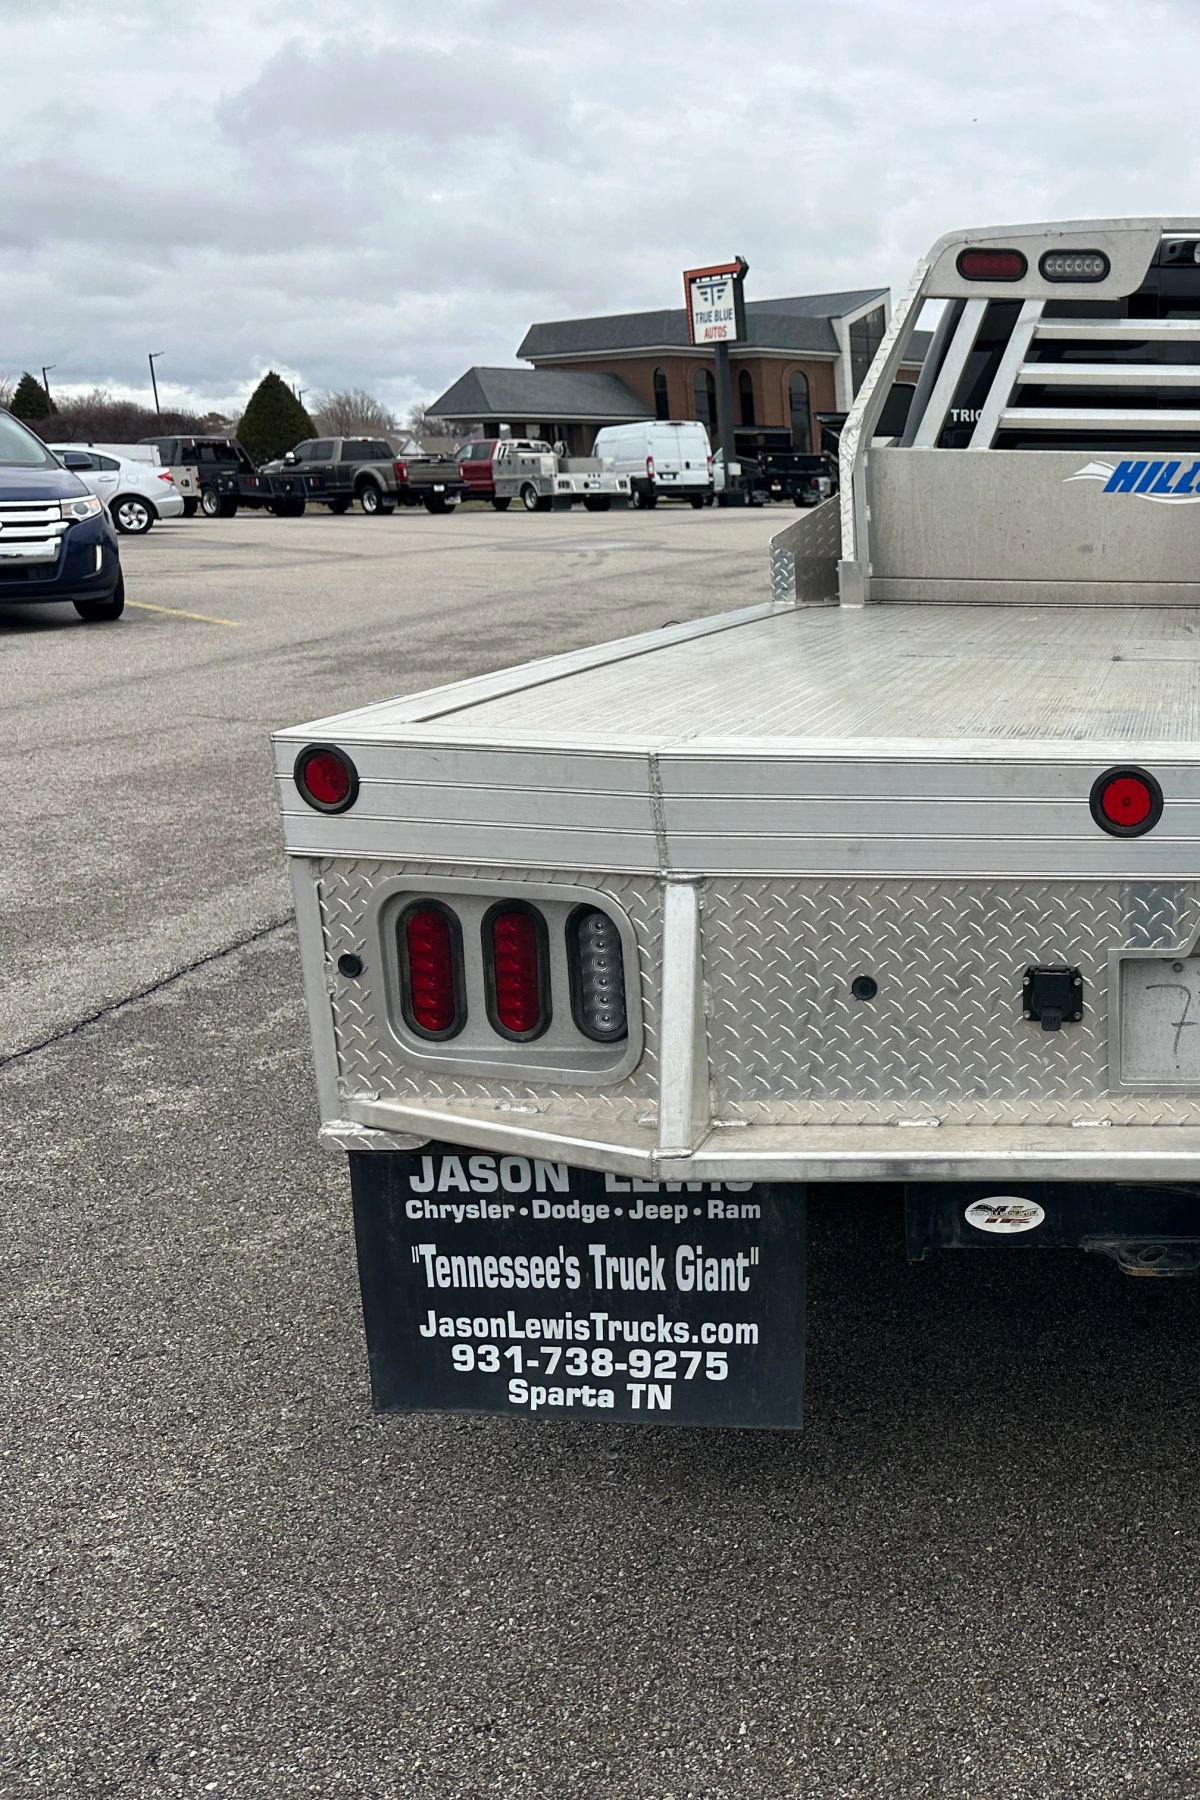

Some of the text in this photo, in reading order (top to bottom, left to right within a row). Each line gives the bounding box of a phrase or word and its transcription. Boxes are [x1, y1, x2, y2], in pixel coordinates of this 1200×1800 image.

[695, 308, 733, 324] TRUE BLUE
[704, 326, 727, 340] AUTOS
[409, 1155, 570, 1193] JASON
[406, 1200, 760, 1223] Chrysler Dodge Jeep Ram
[411, 1244, 758, 1291] "Tennessee's Truck Giant"
[420, 1310, 758, 1344] JasonLewisTrucks.com
[452, 1344, 728, 1380] 931-738-9275
[509, 1379, 671, 1410] Sparta TN
